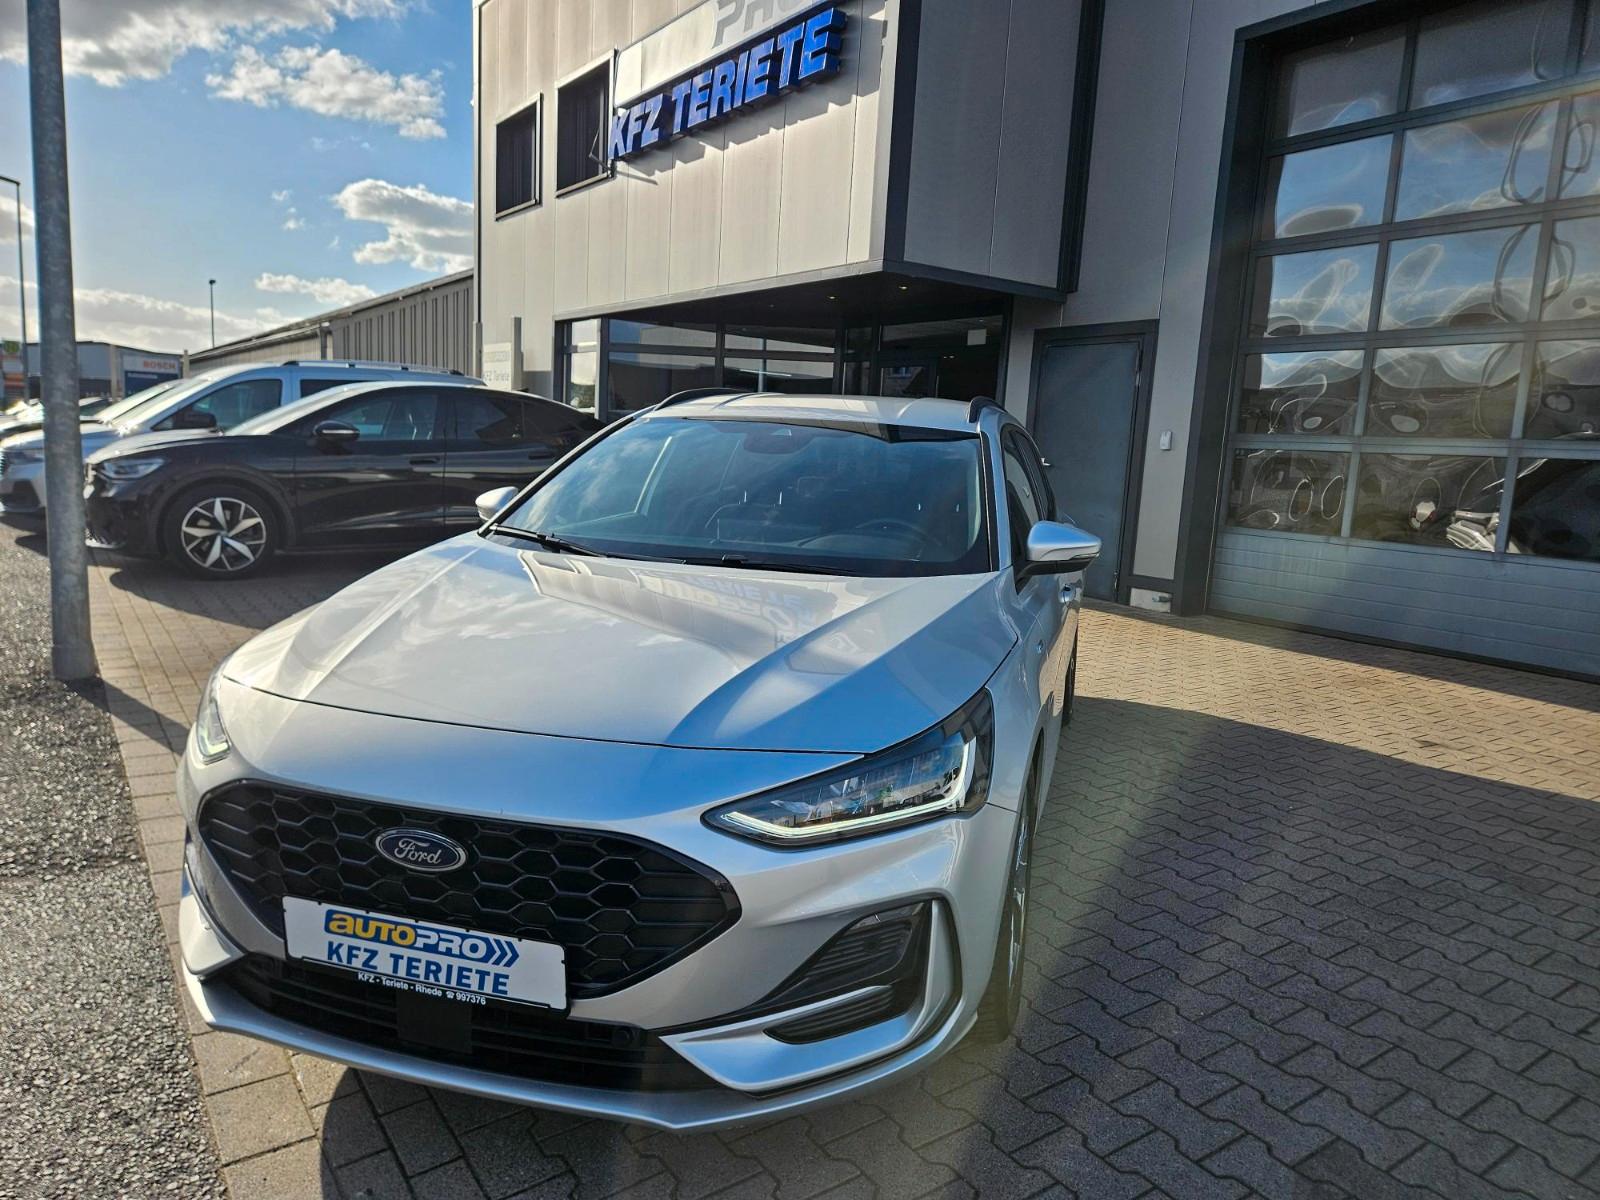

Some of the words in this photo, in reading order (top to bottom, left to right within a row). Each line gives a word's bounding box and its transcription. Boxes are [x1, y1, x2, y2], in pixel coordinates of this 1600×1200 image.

[711, 0, 806, 50] PR
[608, 93, 663, 160] KFZ
[672, 7, 835, 134] TERIETE
[143, 360, 176, 369] BOSCH
[394, 838, 442, 865] Ford
[327, 941, 378, 971] KFZ
[389, 953, 510, 995] TERIETE
[358, 972, 375, 983] KFZ
[381, 976, 409, 991] Teriete
[415, 984, 443, 997] Rhede
[455, 992, 487, 1006] 997376
